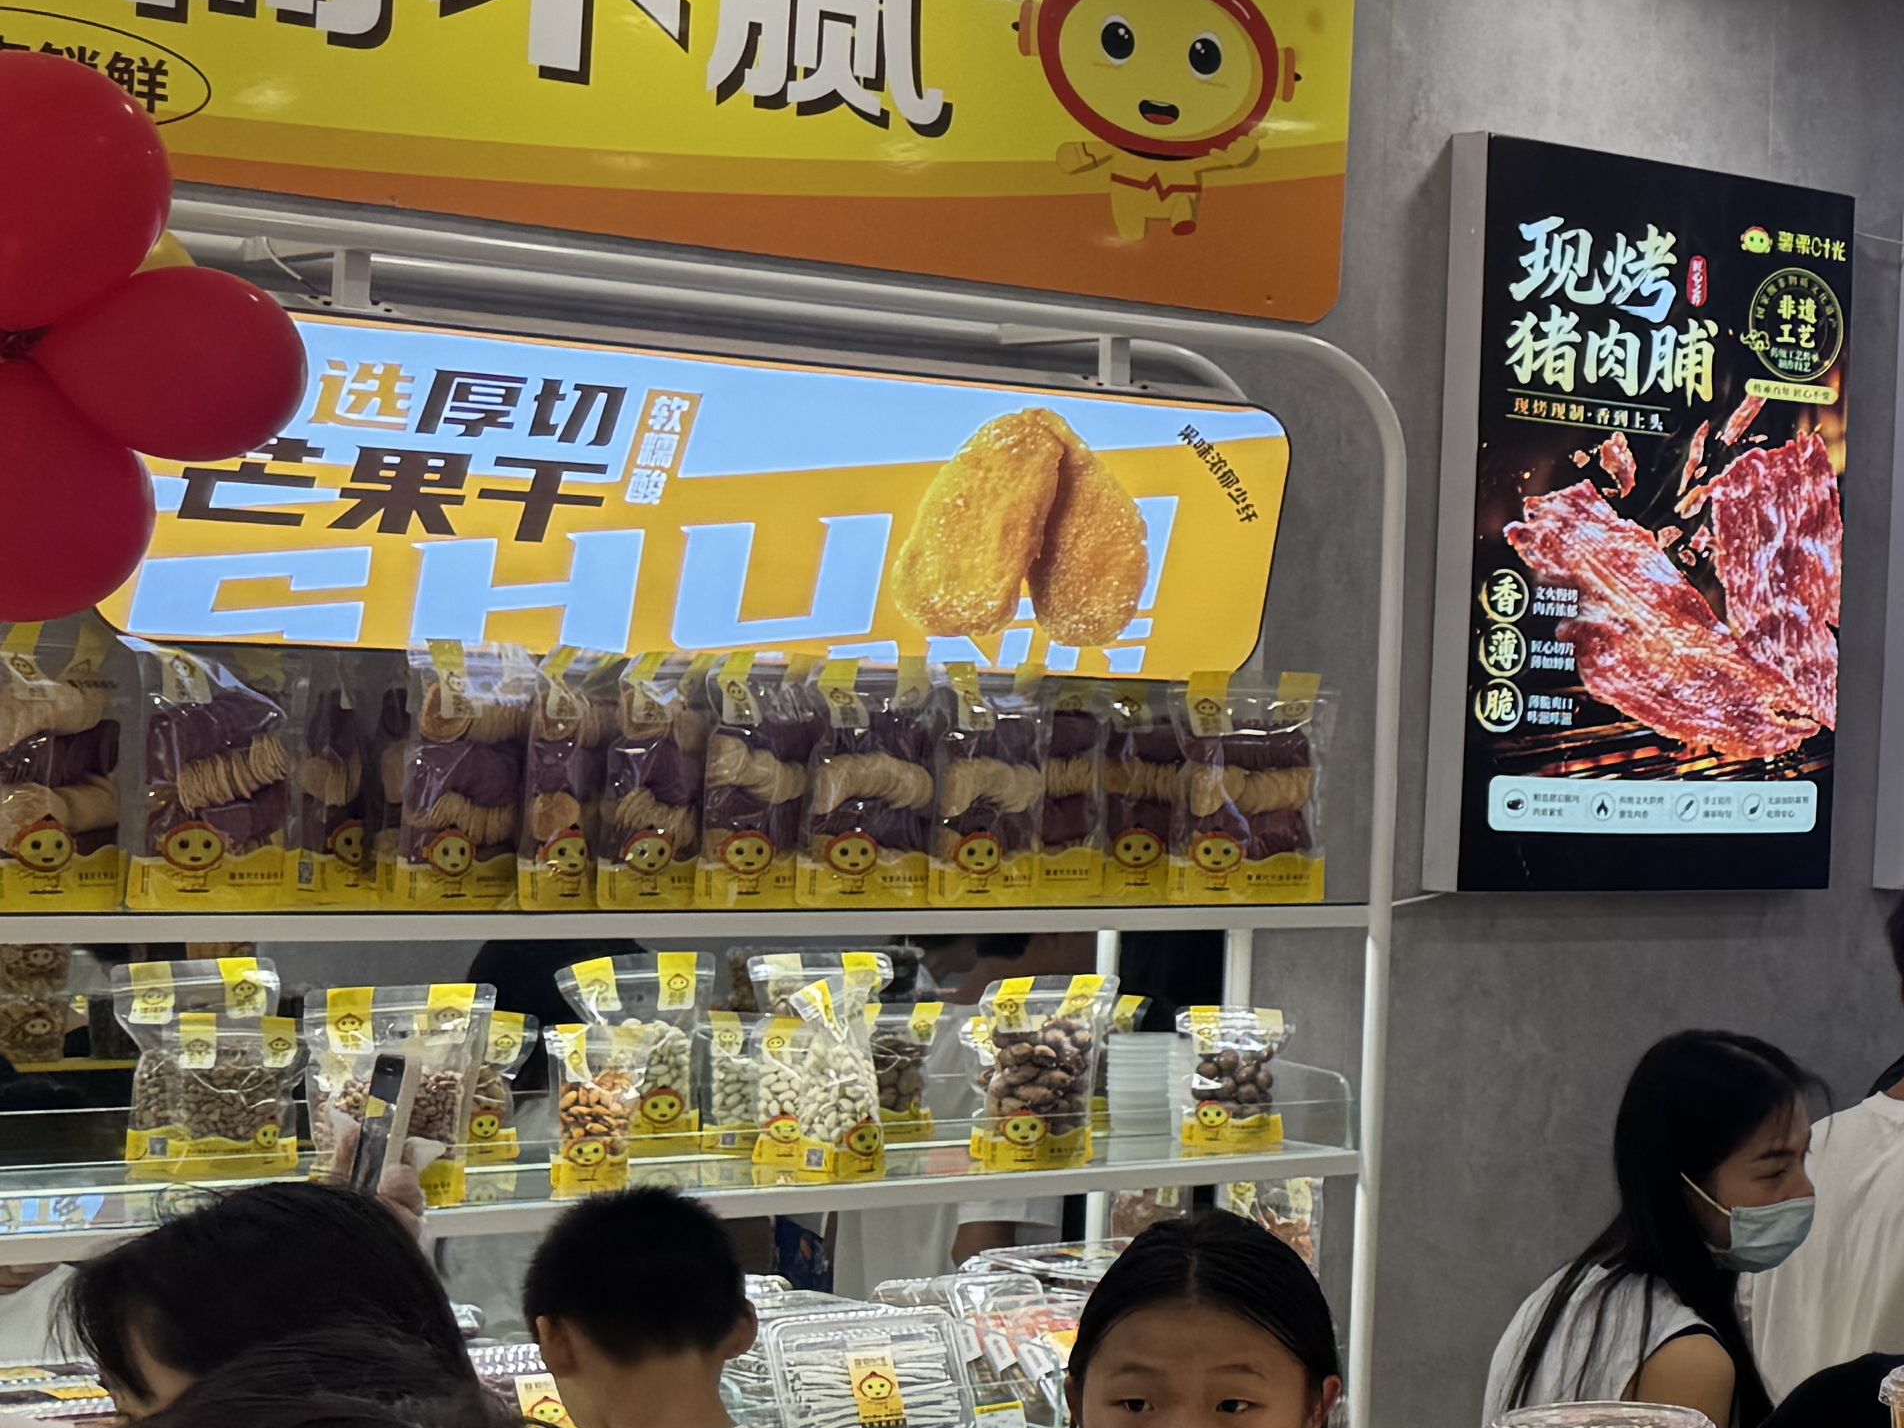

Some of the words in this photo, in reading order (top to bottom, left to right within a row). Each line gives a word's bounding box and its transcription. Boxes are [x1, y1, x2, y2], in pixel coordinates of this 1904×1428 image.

[1509, 216, 1678, 323] 现烤
[1778, 295, 1817, 323] 非遗
[1776, 324, 1815, 348] 工艺
[1505, 305, 1719, 408] 猪肉脯
[176, 436, 610, 543] 芒果干
[1490, 575, 1523, 615] 香
[1489, 630, 1518, 670] 薄
[1483, 687, 1516, 721] 脆
